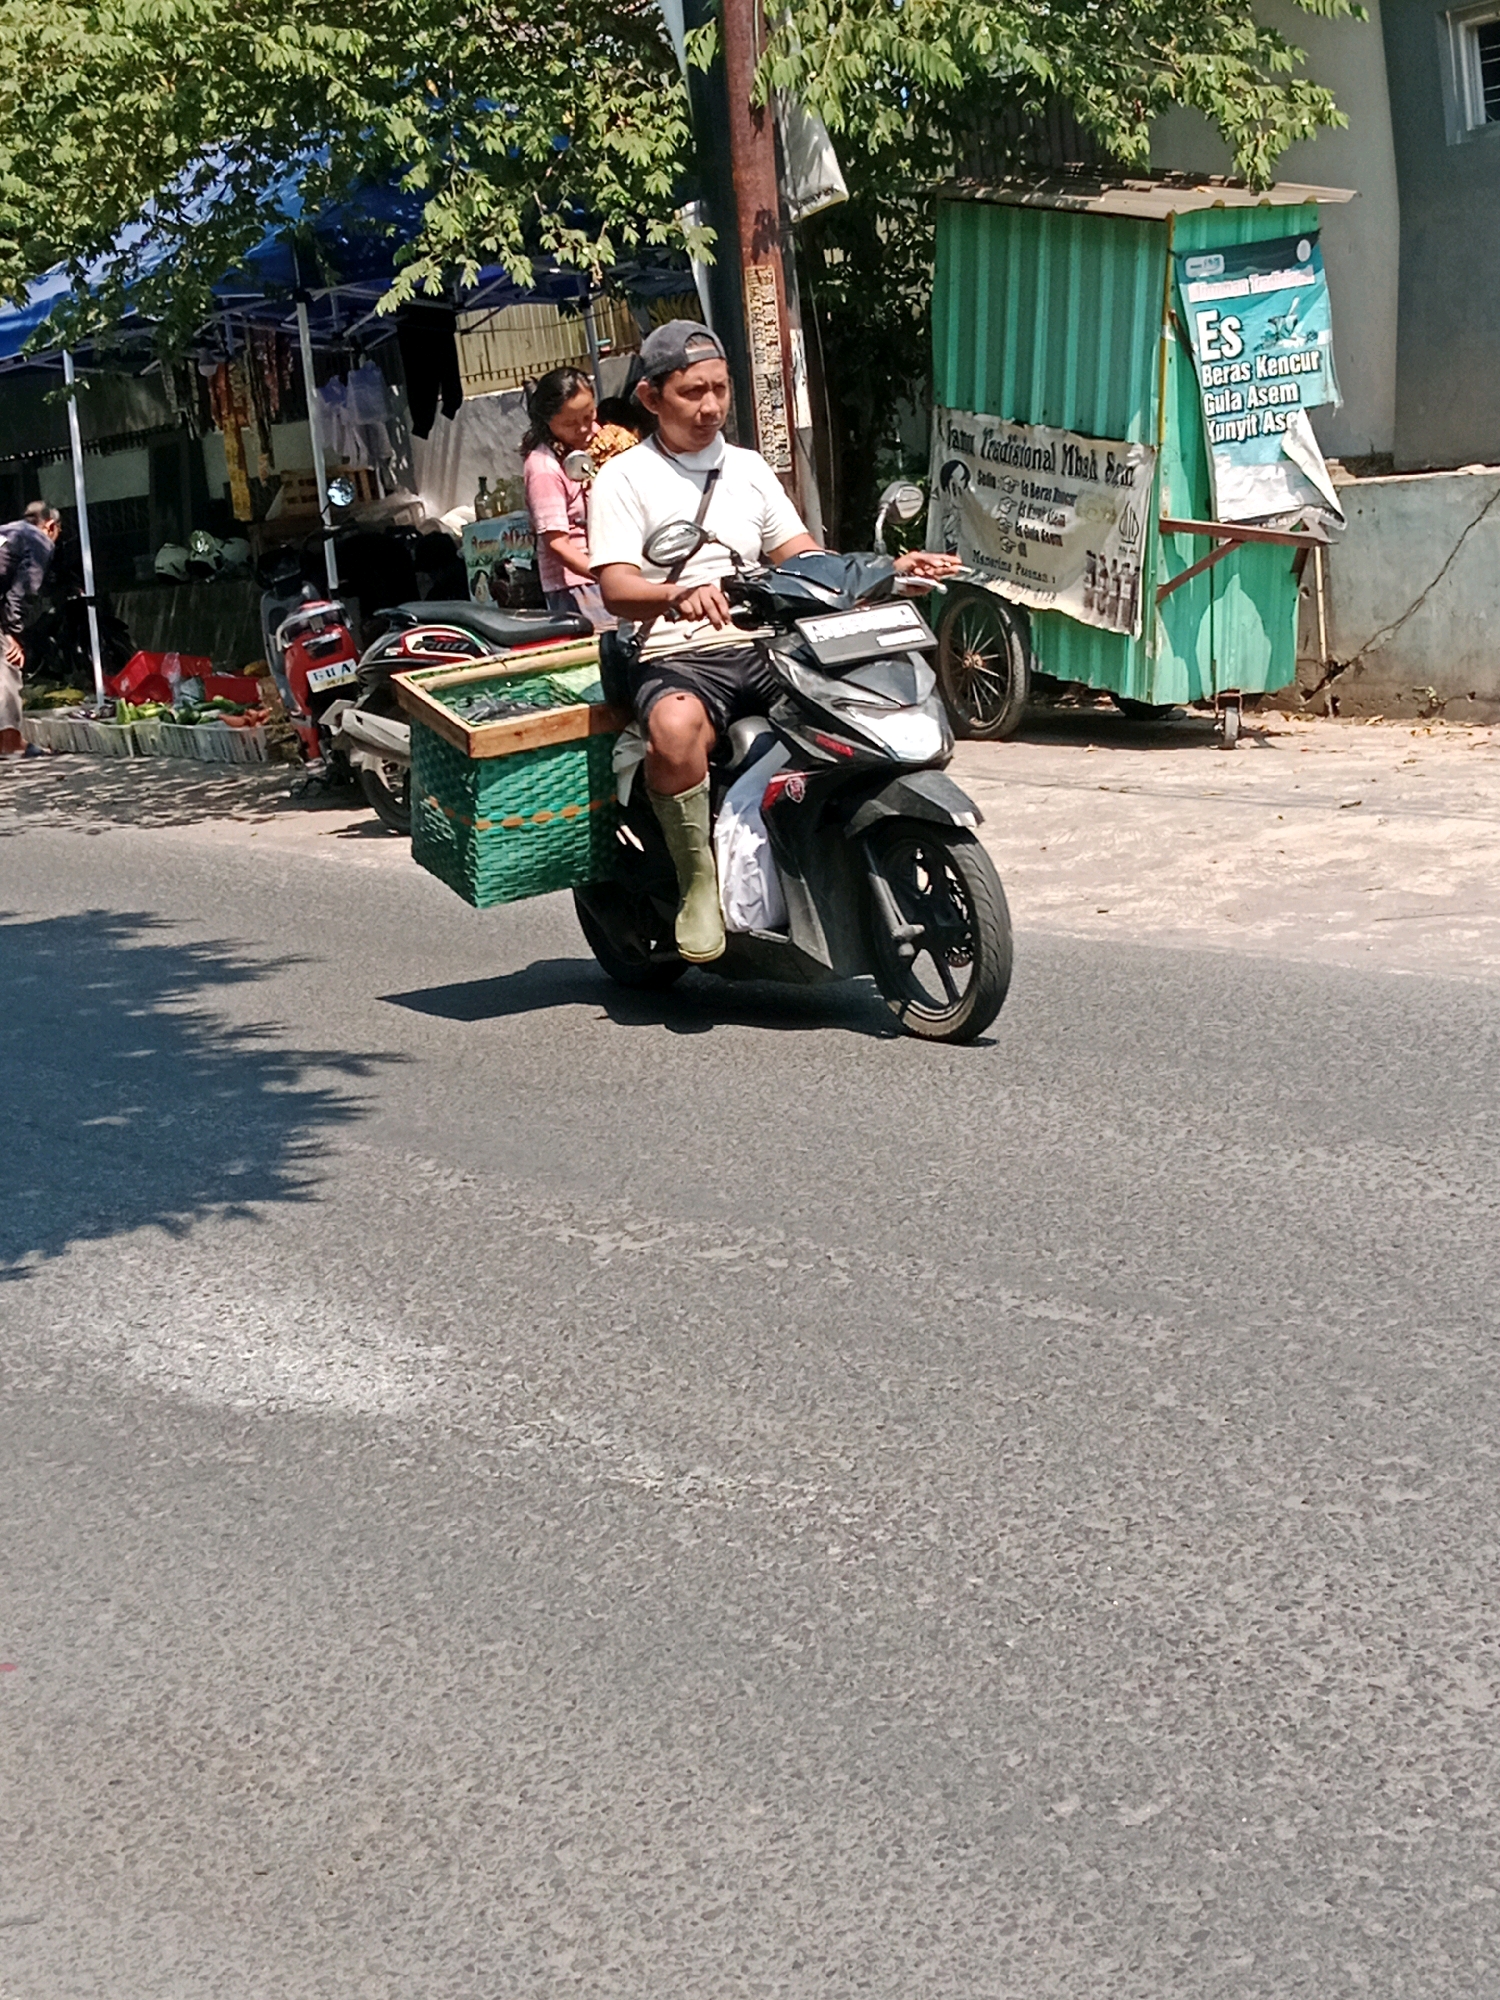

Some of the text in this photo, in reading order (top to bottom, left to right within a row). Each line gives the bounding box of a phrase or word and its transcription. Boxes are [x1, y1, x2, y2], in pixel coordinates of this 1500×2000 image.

[1196, 309, 1243, 362] Es
[1201, 350, 1321, 389] Beras Kencur
[1203, 382, 1300, 417] Gula Asem
[1207, 413, 1259, 444] Kunyit
[980, 427, 1056, 474] Tradisional
[1061, 443, 1098, 481] Mbah
